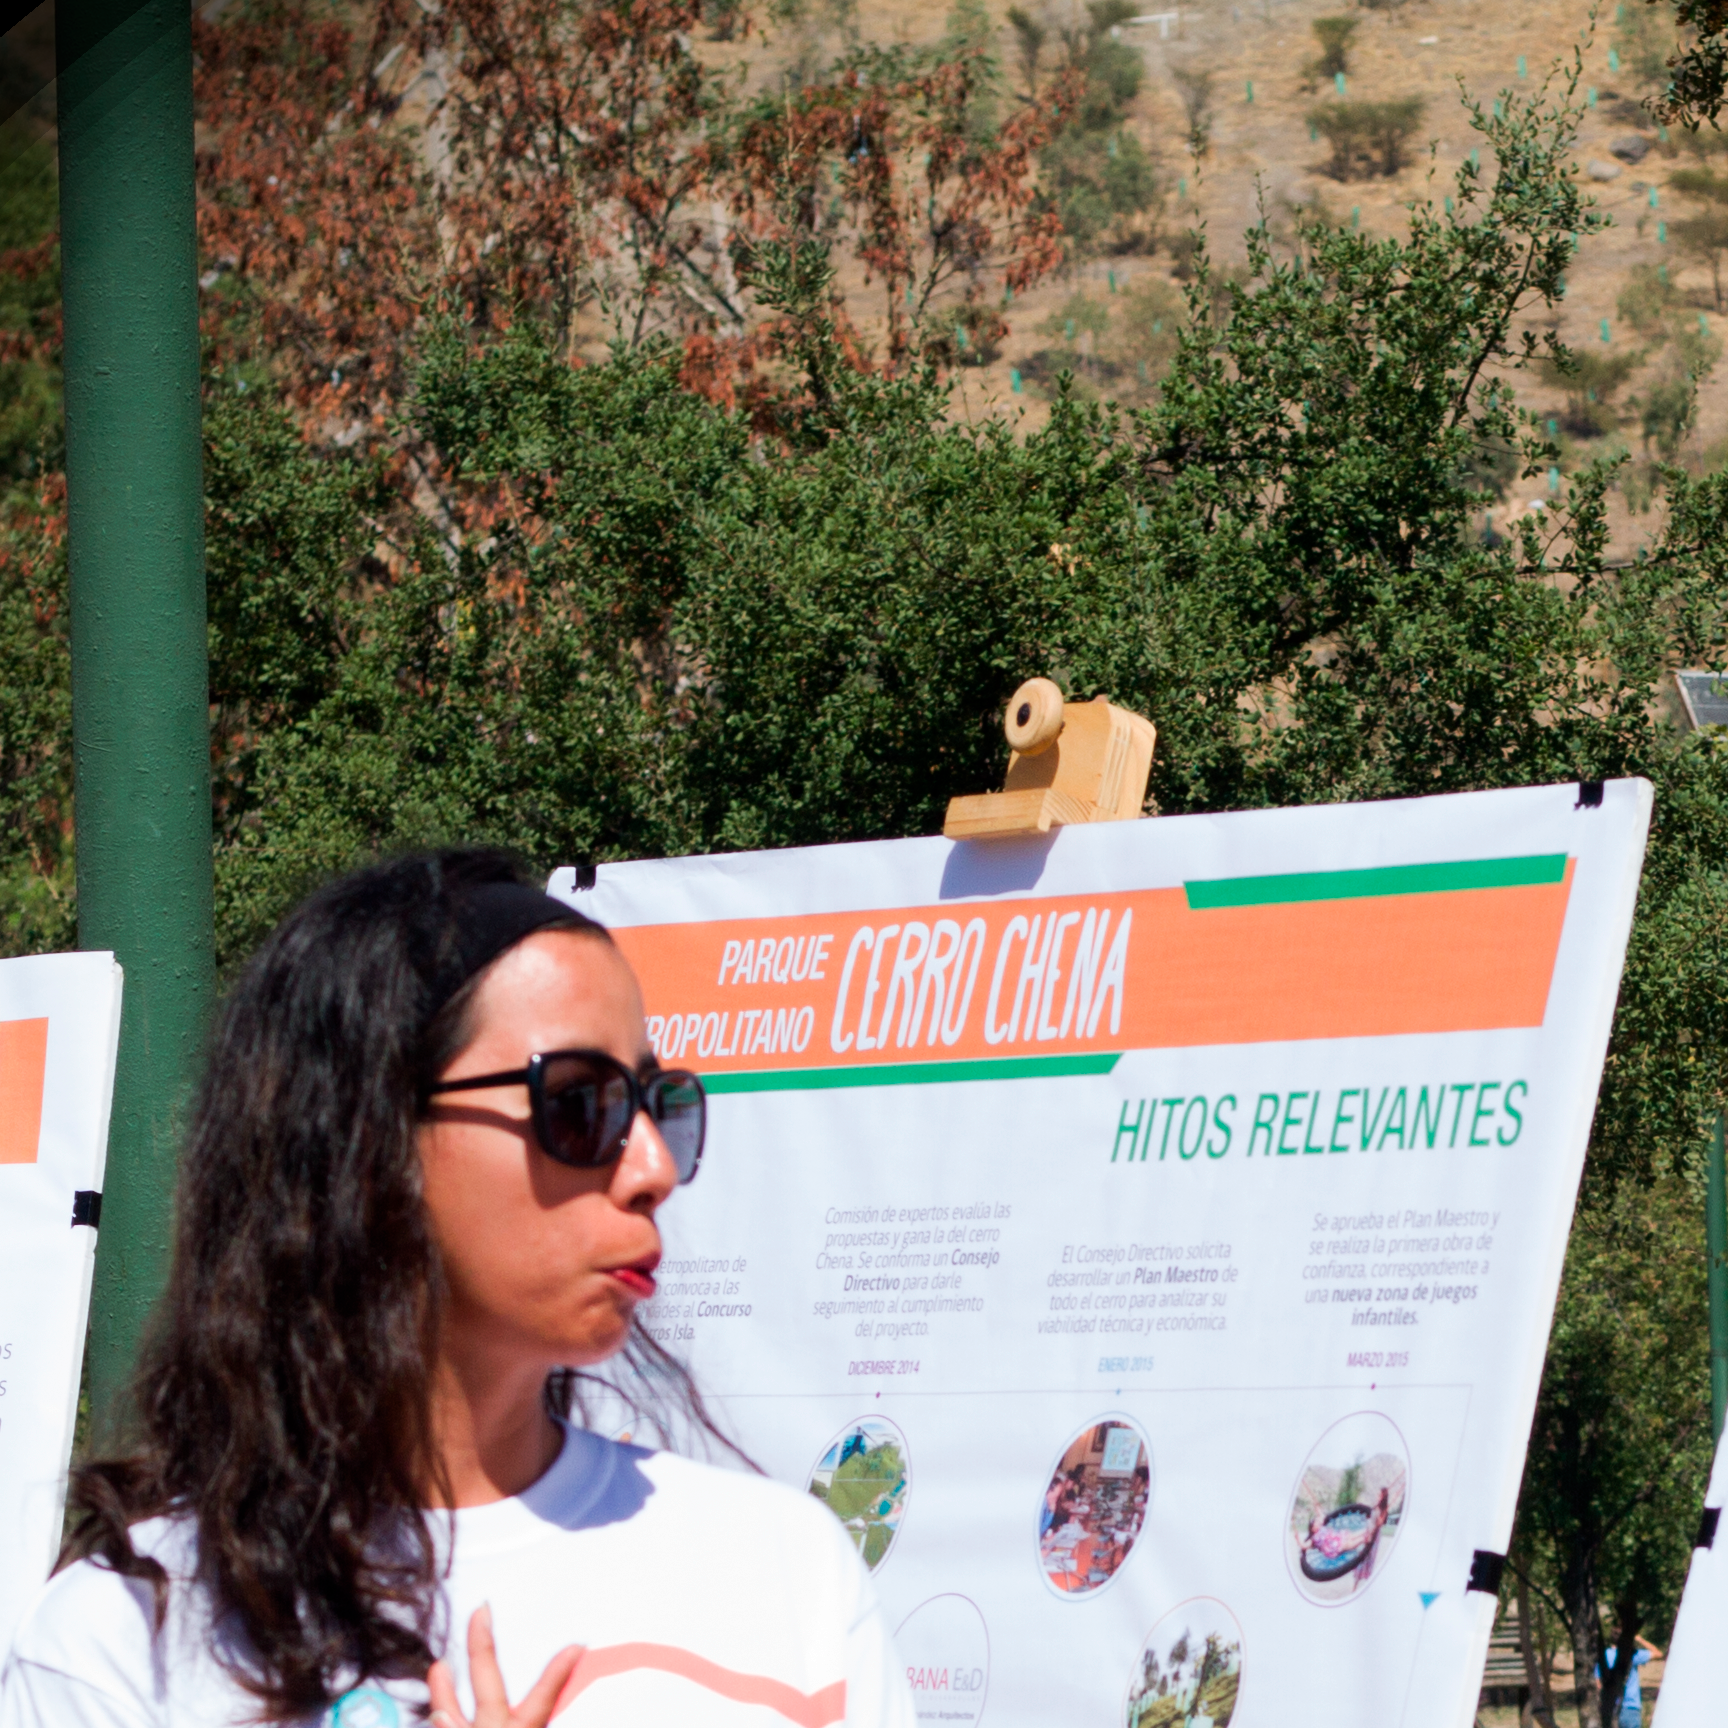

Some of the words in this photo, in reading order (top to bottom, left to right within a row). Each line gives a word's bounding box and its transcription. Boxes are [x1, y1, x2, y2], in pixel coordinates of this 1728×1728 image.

[717, 933, 834, 986] PARQUE
[830, 916, 987, 1054] CERRO
[984, 906, 1132, 1046] CHENA
[645, 1006, 815, 1060] ROPOLITANO
[1110, 1093, 1238, 1163] HITOS
[1246, 1079, 1529, 1158] RELEVANTES
[825, 1206, 879, 1224] Comisión
[881, 1205, 896, 1223] de
[899, 1206, 949, 1226] expertos
[952, 1201, 991, 1220] evalúa
[993, 1201, 1011, 1219] las
[1312, 1212, 1328, 1232] Se
[1330, 1211, 1384, 1234] aprueba
[1387, 1210, 1399, 1230] el
[1402, 1209, 1432, 1229] Plan
[1434, 1209, 1489, 1228] Maestro
[1490, 1210, 1501, 1231] y
[825, 1231, 890, 1251] propuestas
[891, 1234, 900, 1250] y
[901, 1230, 931, 1250] gana
[933, 1226, 944, 1244] la
[947, 1225, 966, 1244] del
[968, 1228, 1000, 1242] cerro
[1309, 1239, 1324, 1256] se
[1326, 1236, 1370, 1255] realiza
[1372, 1235, 1385, 1254] la
[1387, 1235, 1440, 1257] primera
[1442, 1233, 1473, 1252] obra
[1476, 1231, 1493, 1251] de
[732, 1255, 746, 1272] de
[816, 1252, 854, 1270] Chena.
[857, 1251, 872, 1269] Se
[875, 1250, 930, 1268] conforma
[933, 1252, 948, 1266] un
[951, 1248, 1000, 1269] Consejo
[1062, 1244, 1073, 1264] El
[1077, 1244, 1125, 1266] Consejo
[1127, 1242, 1183, 1263] Directivo
[1186, 1240, 1232, 1261] solicita
[1047, 1268, 1113, 1288] desarrollar
[1115, 1271, 1131, 1286] un
[1133, 1267, 1161, 1285] Plan
[1165, 1265, 1219, 1285] Maestro
[1222, 1263, 1238, 1283] de
[1371, 1257, 1478, 1280] correspondiente
[1481, 1259, 1490, 1275] a
[664, 1282, 711, 1296] convoca
[713, 1282, 719, 1296] a
[723, 1278, 740, 1295] las
[843, 1273, 900, 1292] Directivo
[902, 1276, 928, 1293] para
[931, 1271, 962, 1290] darle
[1305, 1288, 1329, 1304] una
[1331, 1287, 1372, 1303] nueva
[1376, 1287, 1409, 1302] zona
[1412, 1282, 1428, 1301] de
[1430, 1282, 1478, 1304] juegos
[682, 1302, 695, 1318] al
[697, 1301, 752, 1317] Concurso
[813, 1297, 885, 1320] seguimiento
[887, 1296, 900, 1314] al
[901, 1294, 984, 1317] cumplimiento
[1049, 1292, 1078, 1312] todo
[1080, 1291, 1092, 1311] el
[1094, 1294, 1127, 1310] cerro
[1128, 1293, 1156, 1312] para
[1158, 1289, 1209, 1309] analizar
[1212, 1291, 1227, 1307] su
[1038, 1314, 1097, 1335] viabilidad
[1099, 1313, 1144, 1334] técnica
[1144, 1317, 1154, 1337] y
[1351, 1306, 1419, 1326] infantiles.
[855, 1319, 873, 1337] del
[874, 1321, 929, 1341] proyecto.
[848, 1360, 896, 1376] DICIEMBRE
[897, 1359, 920, 1375] 2014
[1098, 1356, 1129, 1373] ENERO
[1346, 1351, 1384, 1367] MARZO
